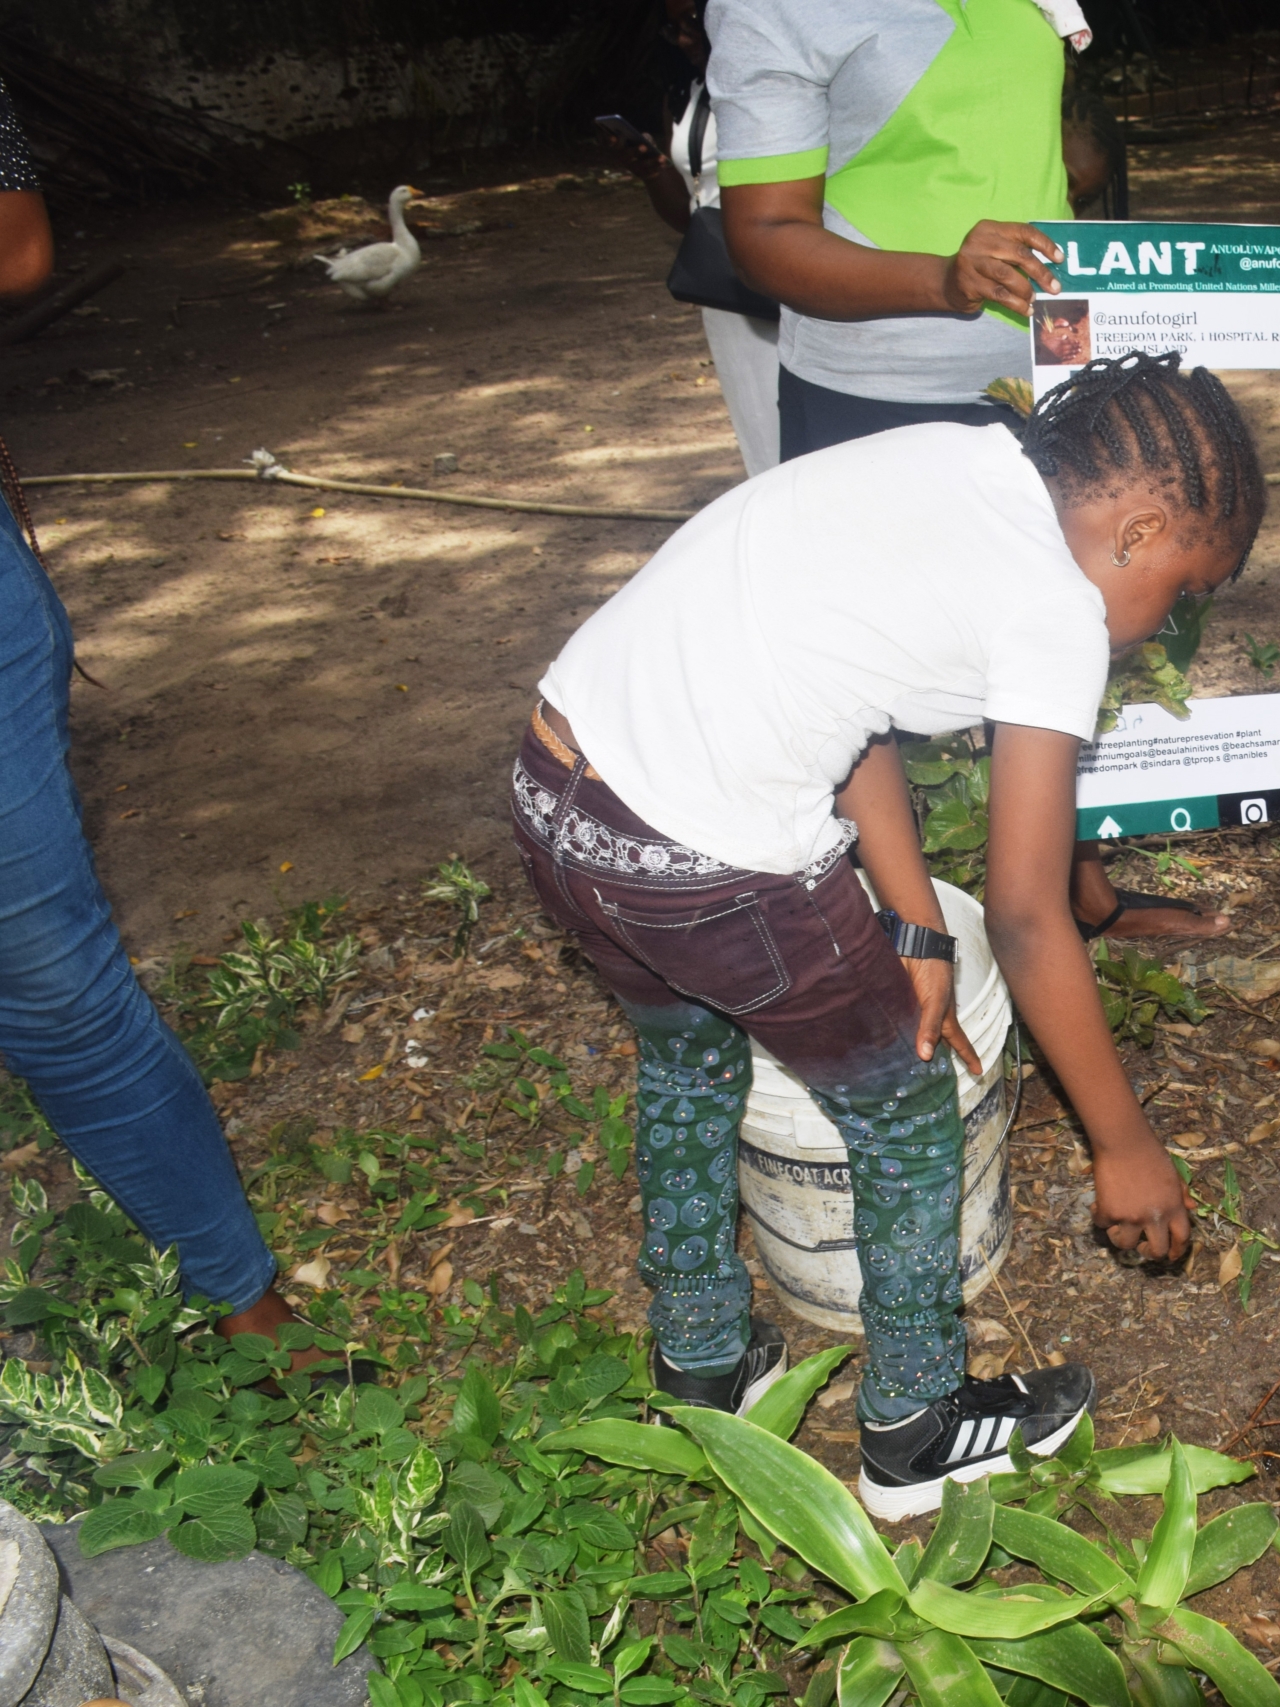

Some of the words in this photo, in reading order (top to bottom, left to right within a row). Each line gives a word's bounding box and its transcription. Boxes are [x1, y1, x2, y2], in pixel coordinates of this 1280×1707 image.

[1107, 282, 1136, 291] Aimed
[1138, 283, 1147, 291] at
[1149, 282, 1194, 292] Promoting
[1195, 282, 1224, 291] United
[1225, 282, 1258, 292] Nations
[1094, 311, 1197, 329] @anufotogirl
[1096, 332, 1156, 342] FREEDOM
[1161, 332, 1197, 343] PARK,
[1209, 332, 1268, 342] HOSPITAL
[1096, 345, 1139, 355] LAGOS
[1143, 344, 1188, 355] ISLAND
[1236, 729, 1262, 738] #plant
[1140, 759, 1181, 770] @sindara
[1223, 750, 1268, 762] @manibles
[757, 1153, 819, 1184] FINECOAT
